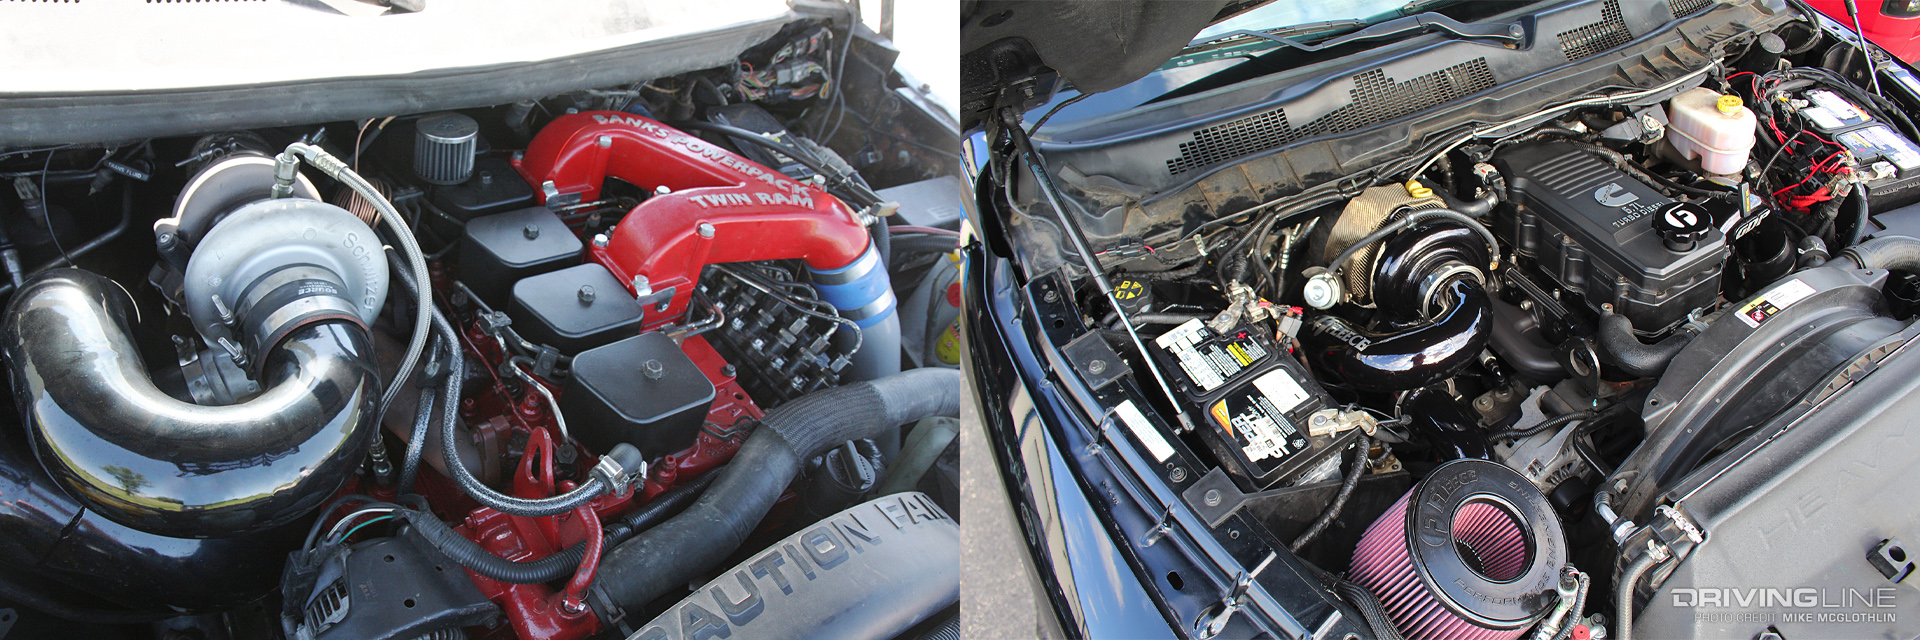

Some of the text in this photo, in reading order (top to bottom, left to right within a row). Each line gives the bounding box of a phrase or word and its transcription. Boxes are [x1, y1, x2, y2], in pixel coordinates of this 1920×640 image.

[592, 114, 811, 197] BANKS POWERPACK
[689, 191, 815, 210] TWIN RAM
[1621, 201, 1645, 214] 6.7L
[1612, 211, 1641, 228] TURBO
[343, 232, 379, 314] Schwitzer
[1452, 572, 1551, 607] PERFORMANCE
